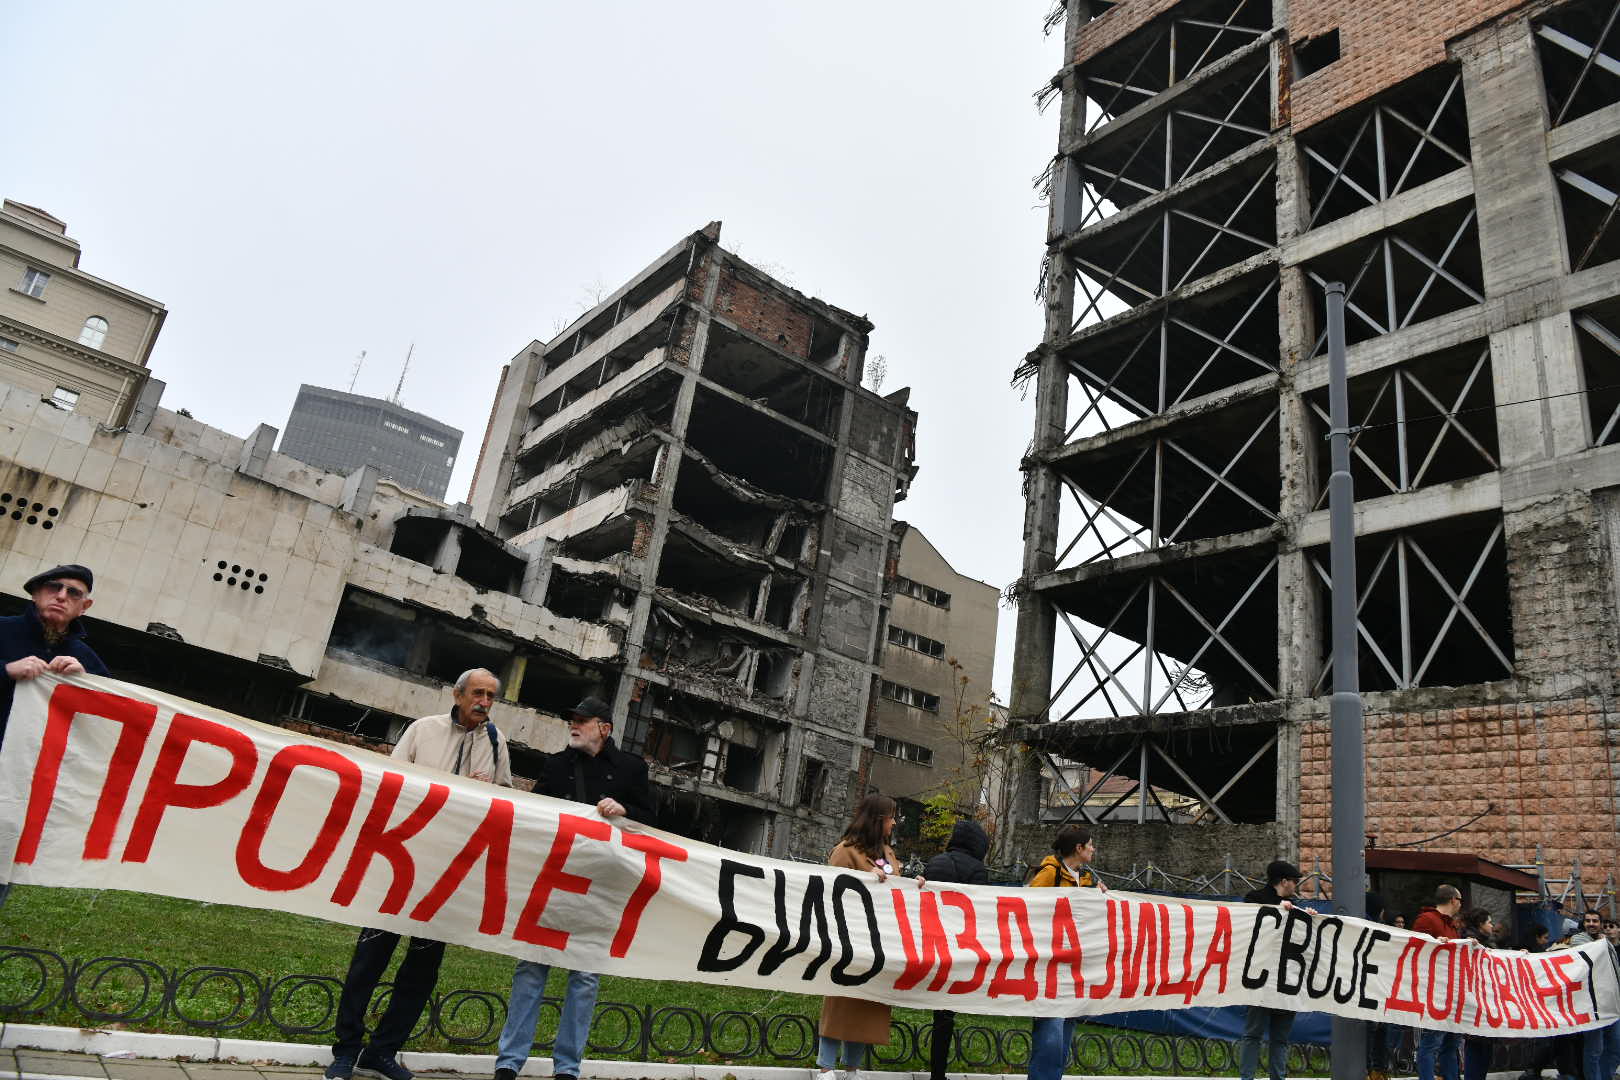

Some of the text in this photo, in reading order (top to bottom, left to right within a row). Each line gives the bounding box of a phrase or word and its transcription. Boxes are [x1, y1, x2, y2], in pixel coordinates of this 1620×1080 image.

[15, 684, 688, 958] ПРОКЛЕТ
[697, 859, 885, 986] БИО
[892, 888, 1232, 1005] ИЗДАЈИЦА
[1241, 906, 1391, 1010] СВОЈЕ
